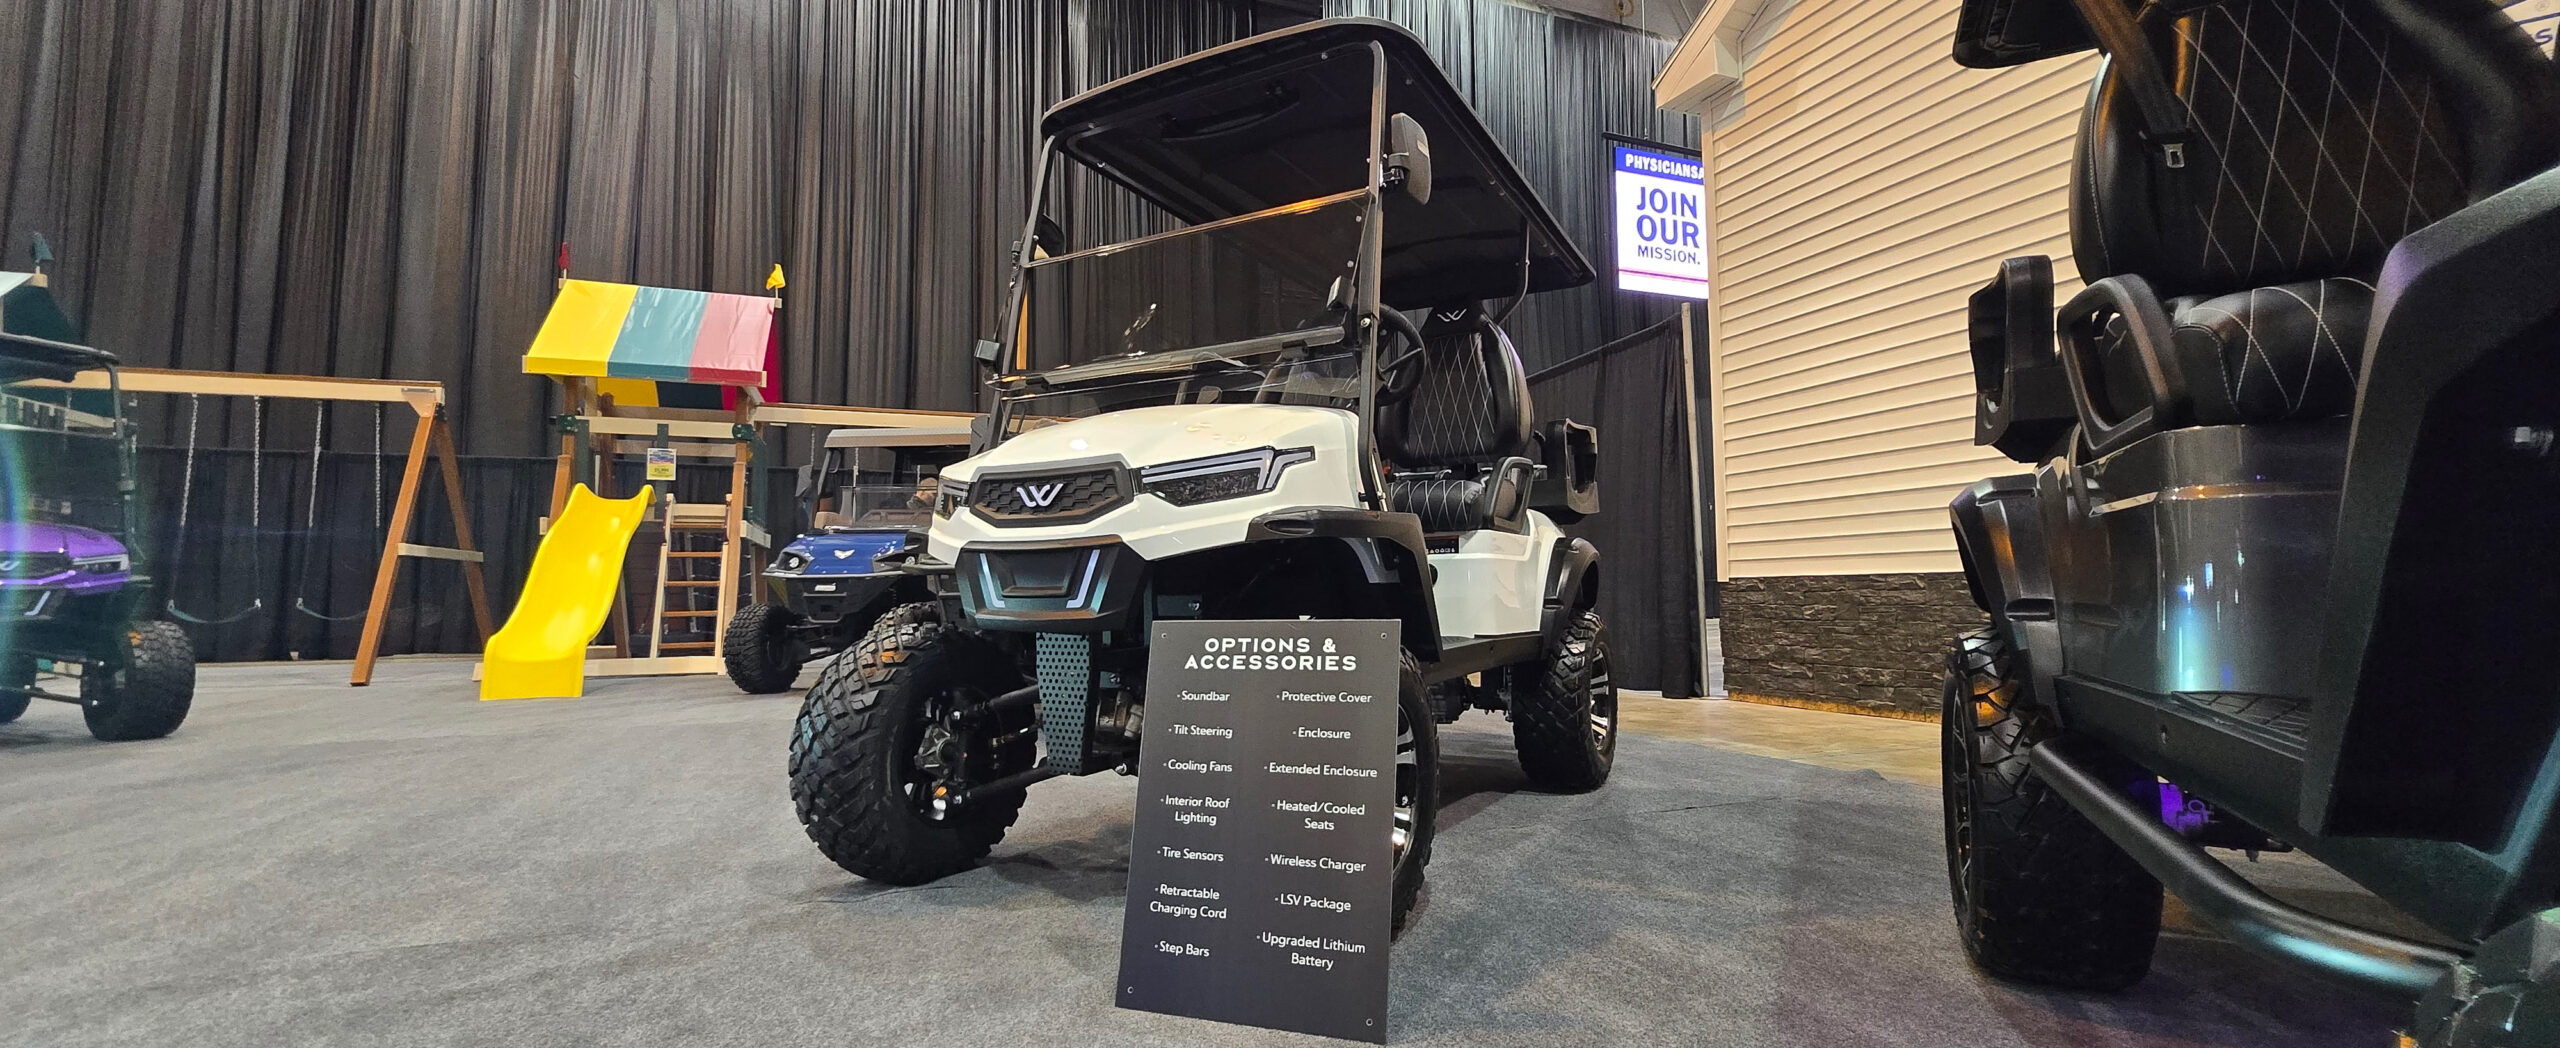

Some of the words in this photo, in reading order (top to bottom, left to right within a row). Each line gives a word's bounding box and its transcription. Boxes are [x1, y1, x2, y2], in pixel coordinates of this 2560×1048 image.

[1636, 186, 1698, 219] JOIN
[1636, 214, 1700, 249] OUR
[1637, 245, 1701, 265] MISSION.
[1205, 638, 1309, 652] OPTIONS
[1322, 637, 1337, 653] &
[1185, 655, 1356, 670] ACCESSORIES
[1181, 690, 1231, 702] Soundbar
[1281, 690, 1337, 703] Protective
[1338, 691, 1373, 703] Cover
[1173, 724, 1189, 735] Tilt
[1190, 724, 1233, 739] Steering
[1298, 726, 1351, 739] Enclosure
[1167, 758, 1208, 774] Cooling
[1209, 760, 1233, 772] Fans
[1269, 762, 1321, 775] Extended
[1323, 764, 1378, 778] Enclosure
[1165, 794, 1204, 807] Interior
[1204, 796, 1231, 809] Roof
[1276, 799, 1366, 816] Heated/Cooled
[1174, 811, 1217, 827] Lighting
[1304, 817, 1335, 831] Seats
[1162, 846, 1181, 859] Tire
[1183, 848, 1224, 862] Sensors
[1270, 853, 1317, 868] Wireless
[1319, 857, 1367, 874] Charger
[1159, 883, 1220, 900] Retractable
[1149, 900, 1198, 919] Charging
[1199, 905, 1227, 919] Cord
[1280, 893, 1302, 906] LSV
[1303, 895, 1352, 913] Package
[1159, 940, 1184, 957] Step
[1185, 943, 1210, 957] Bars
[1262, 931, 1321, 949] Upgraded
[1323, 938, 1366, 954] Lithium
[1291, 952, 1334, 971] Battery
